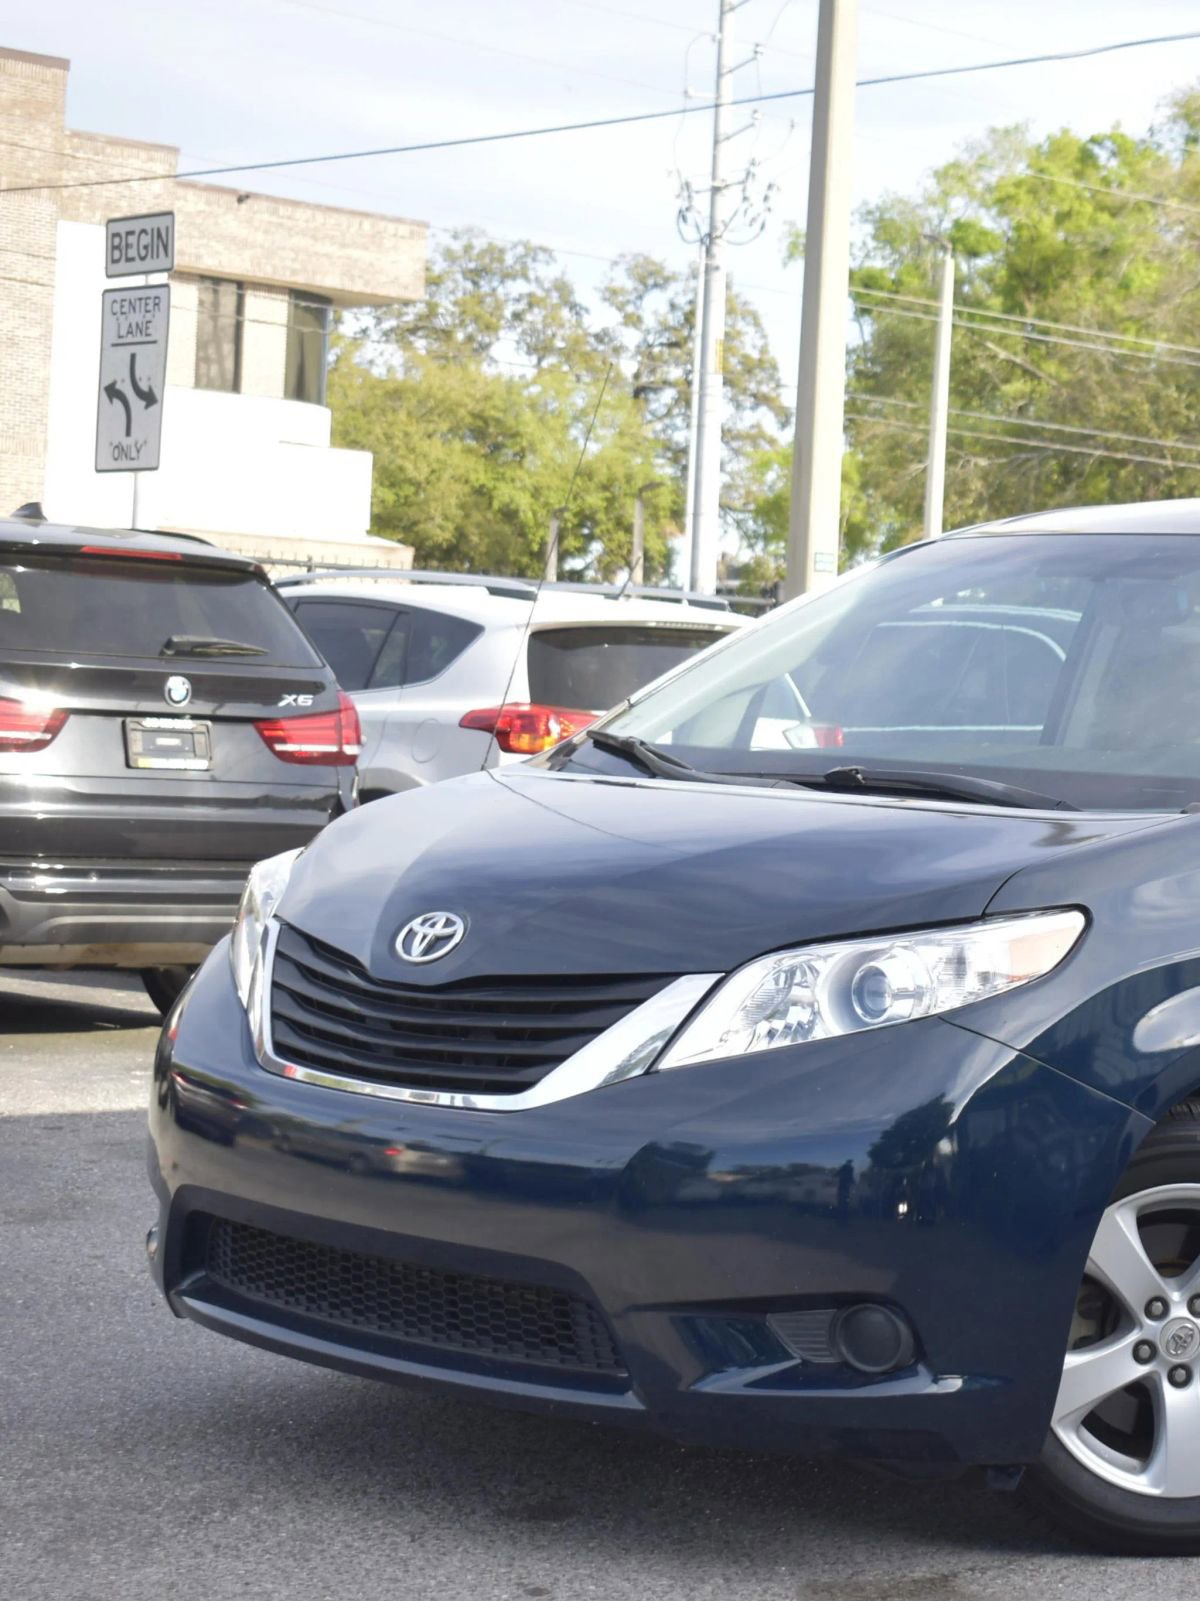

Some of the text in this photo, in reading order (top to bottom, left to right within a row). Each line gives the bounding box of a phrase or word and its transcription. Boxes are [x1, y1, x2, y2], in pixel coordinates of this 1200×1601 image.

[110, 225, 169, 264] BEGIN
[111, 295, 161, 316] CENTER
[116, 320, 153, 339] LANE
[112, 440, 144, 462] ONLY
